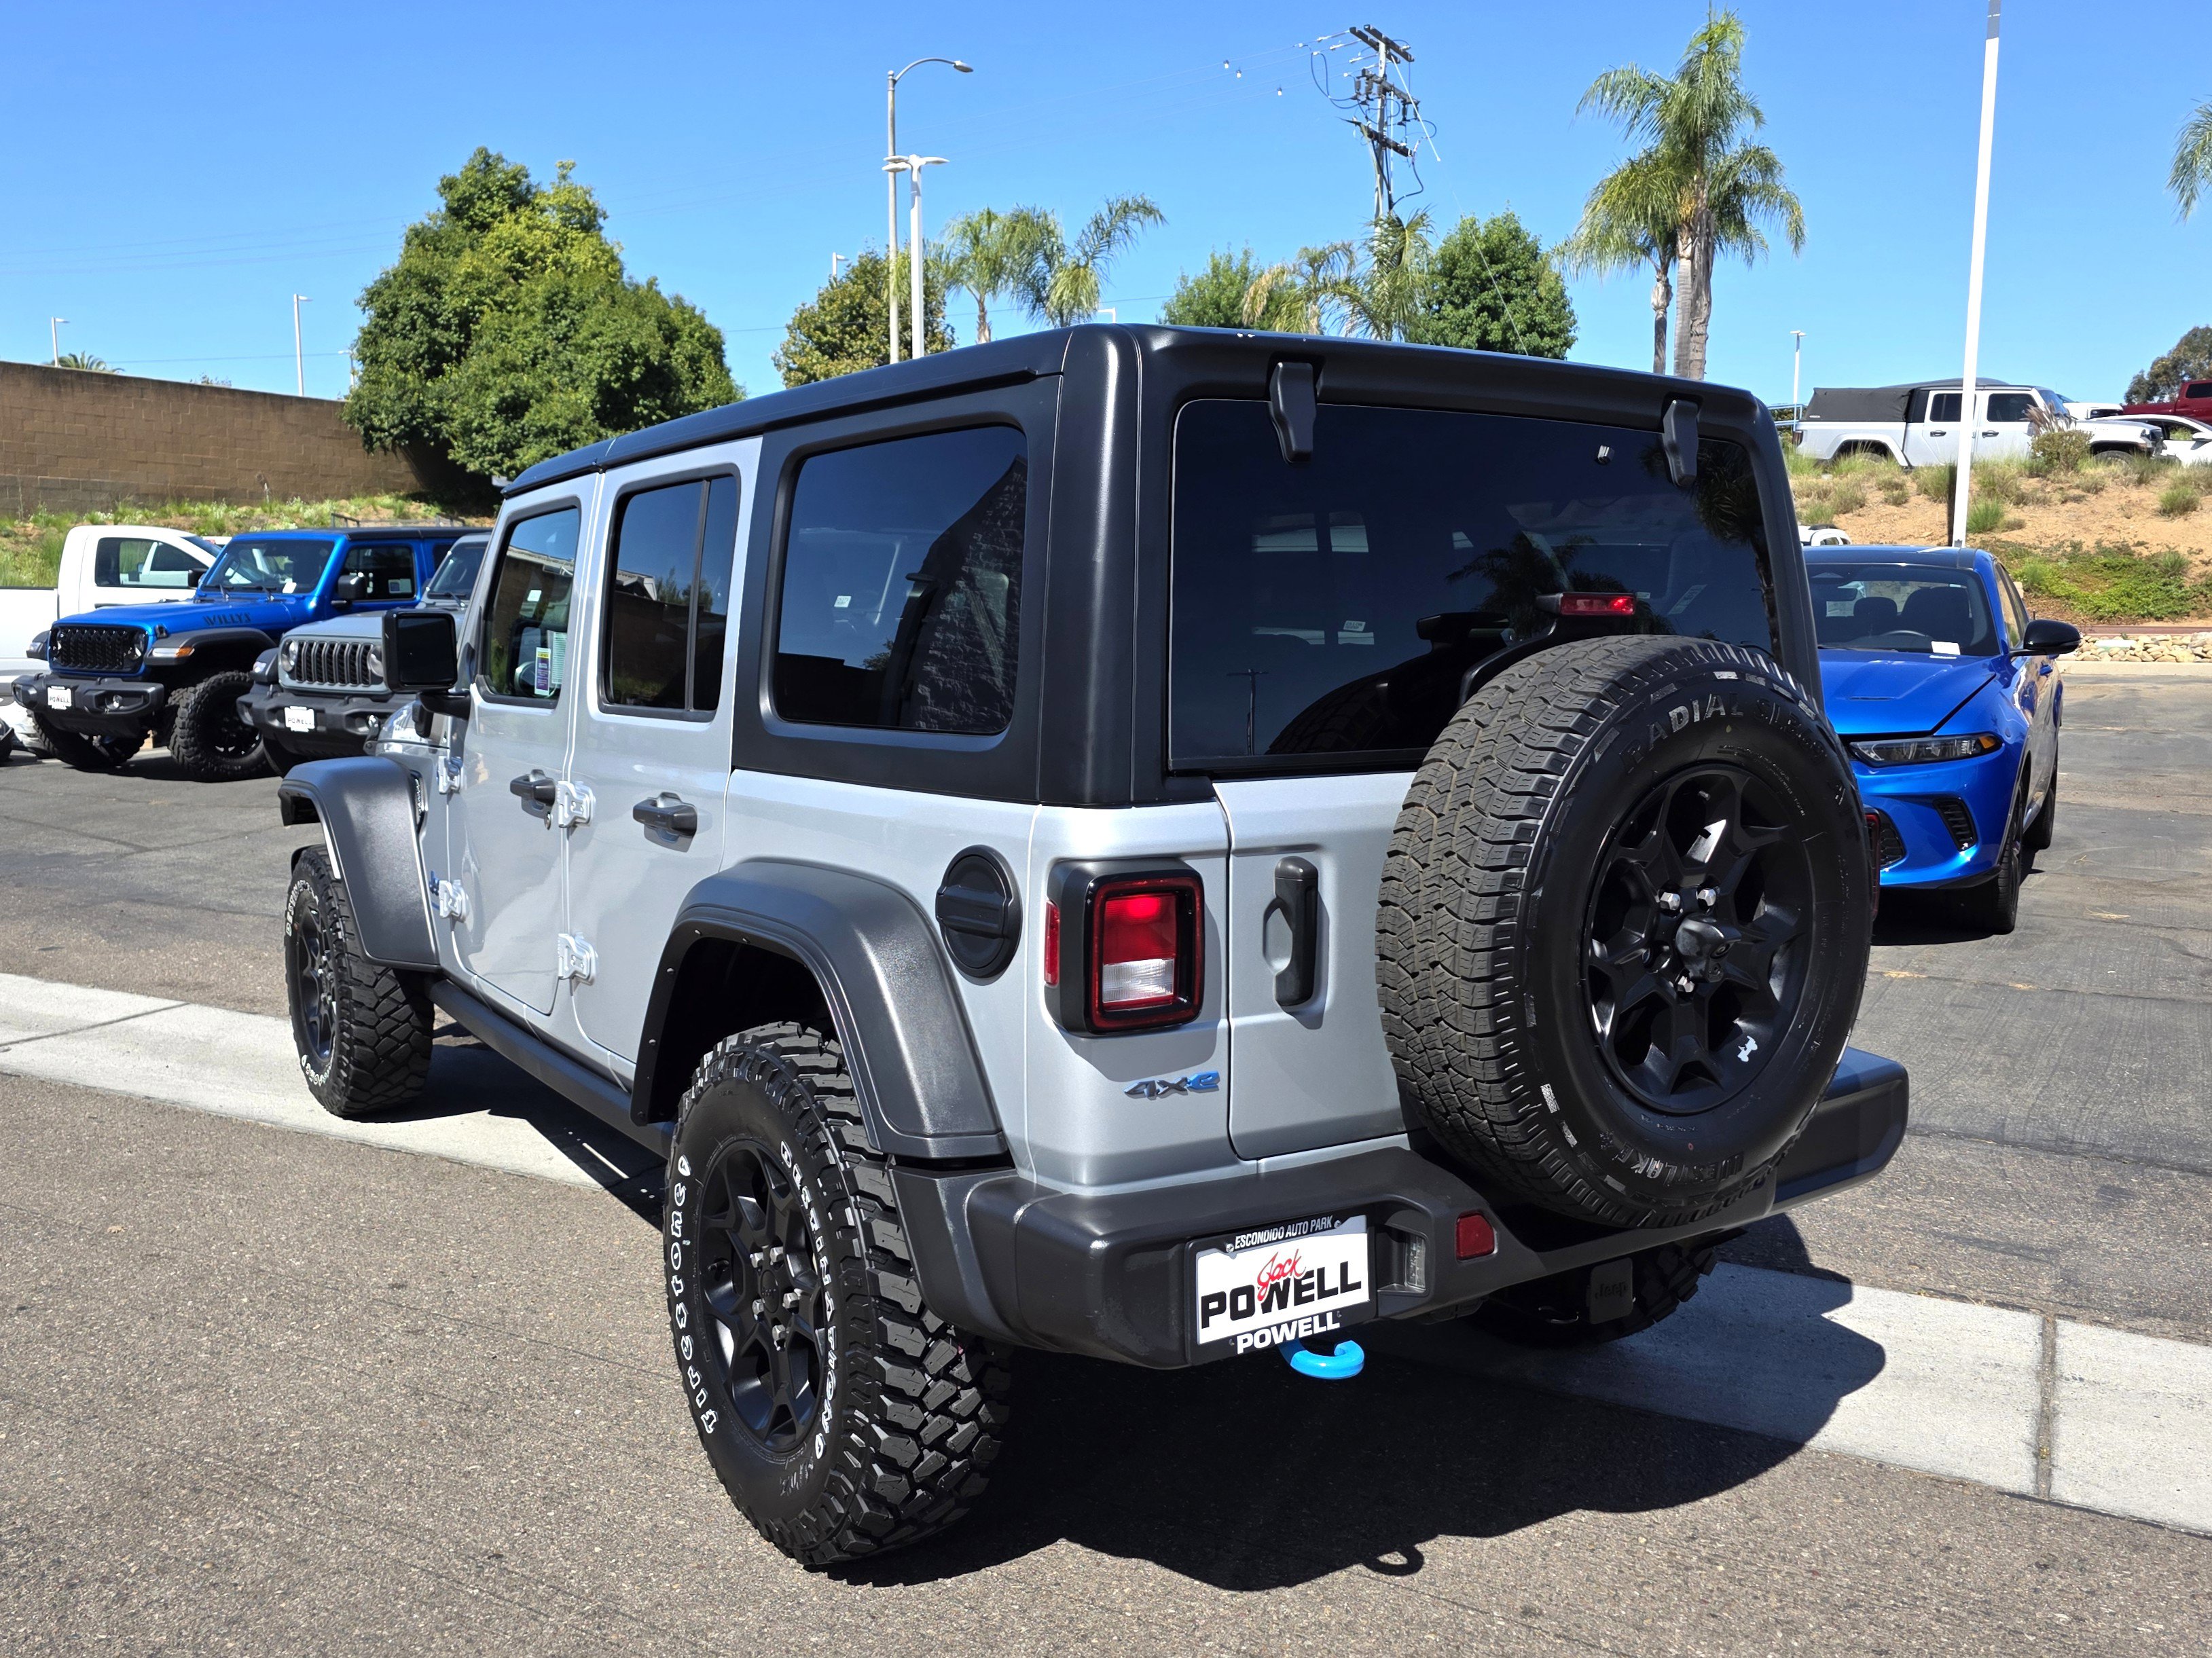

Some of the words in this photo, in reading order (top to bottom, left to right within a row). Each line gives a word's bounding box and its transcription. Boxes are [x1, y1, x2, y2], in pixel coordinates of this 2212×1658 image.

[202, 612, 251, 626] WILLYS
[1619, 692, 1744, 774] RADIAL
[1612, 1141, 1744, 1187] WESTLAKE
[1234, 1225, 1285, 1250] ESCONDIDO
[1285, 1221, 1309, 1238] AUTO
[1309, 1215, 1333, 1232] PARK
[1201, 1260, 1362, 1329] POWELL
[1256, 1248, 1307, 1302] Jack
[1595, 1280, 1627, 1300] Jeep
[1236, 1310, 1341, 1355] POWELL
